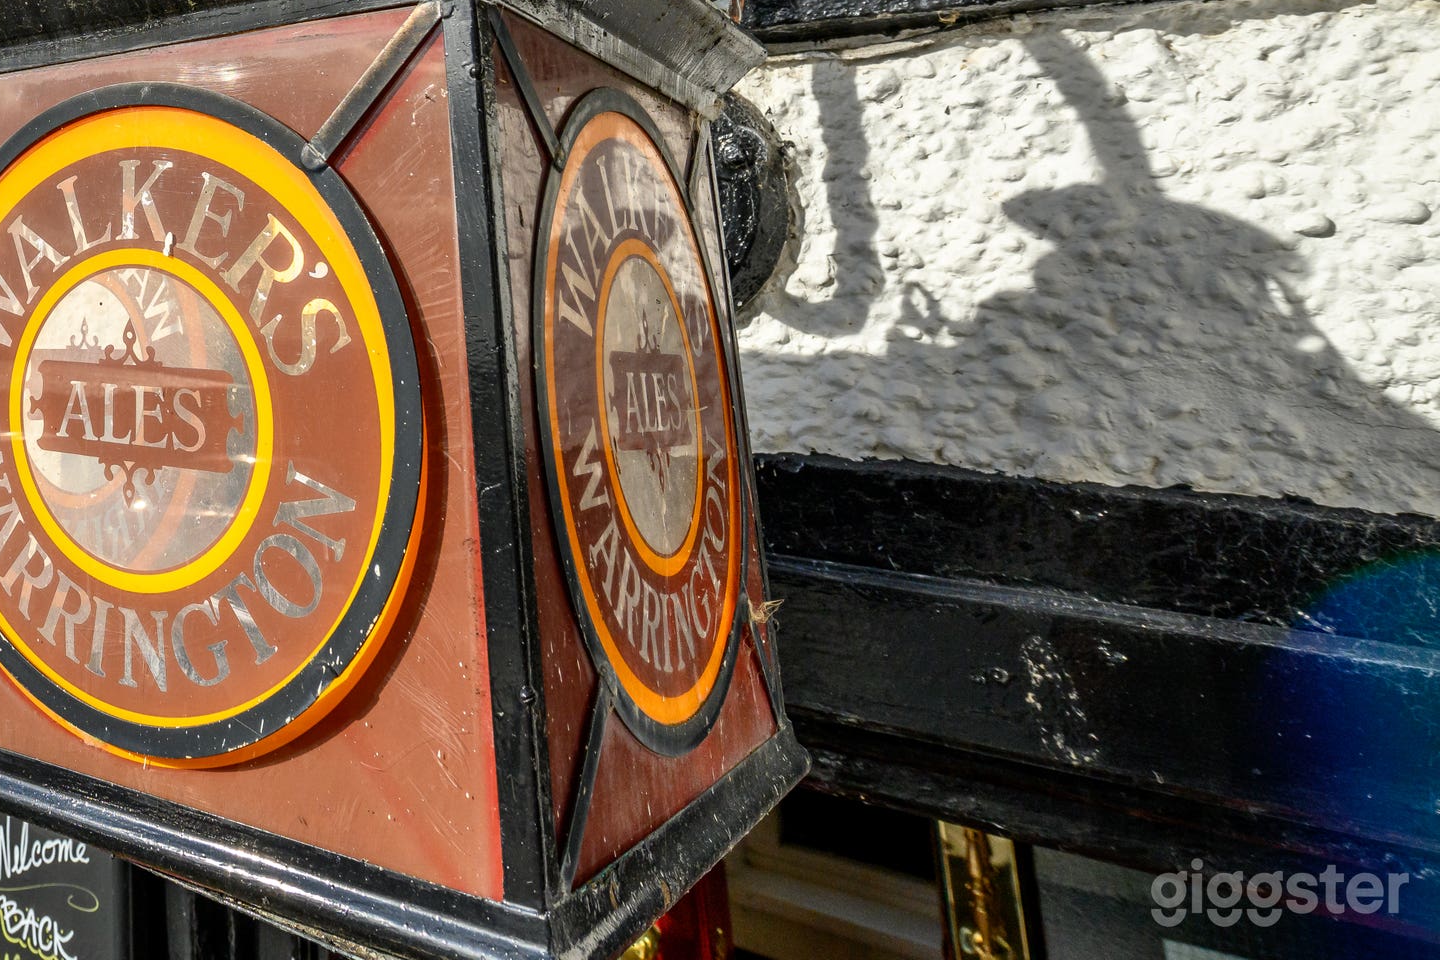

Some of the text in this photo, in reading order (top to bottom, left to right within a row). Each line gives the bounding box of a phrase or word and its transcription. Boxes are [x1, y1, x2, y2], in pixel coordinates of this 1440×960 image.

[55, 380, 207, 453] ALES
[624, 370, 683, 435] ALES
[572, 417, 726, 672] WARRINGTON
